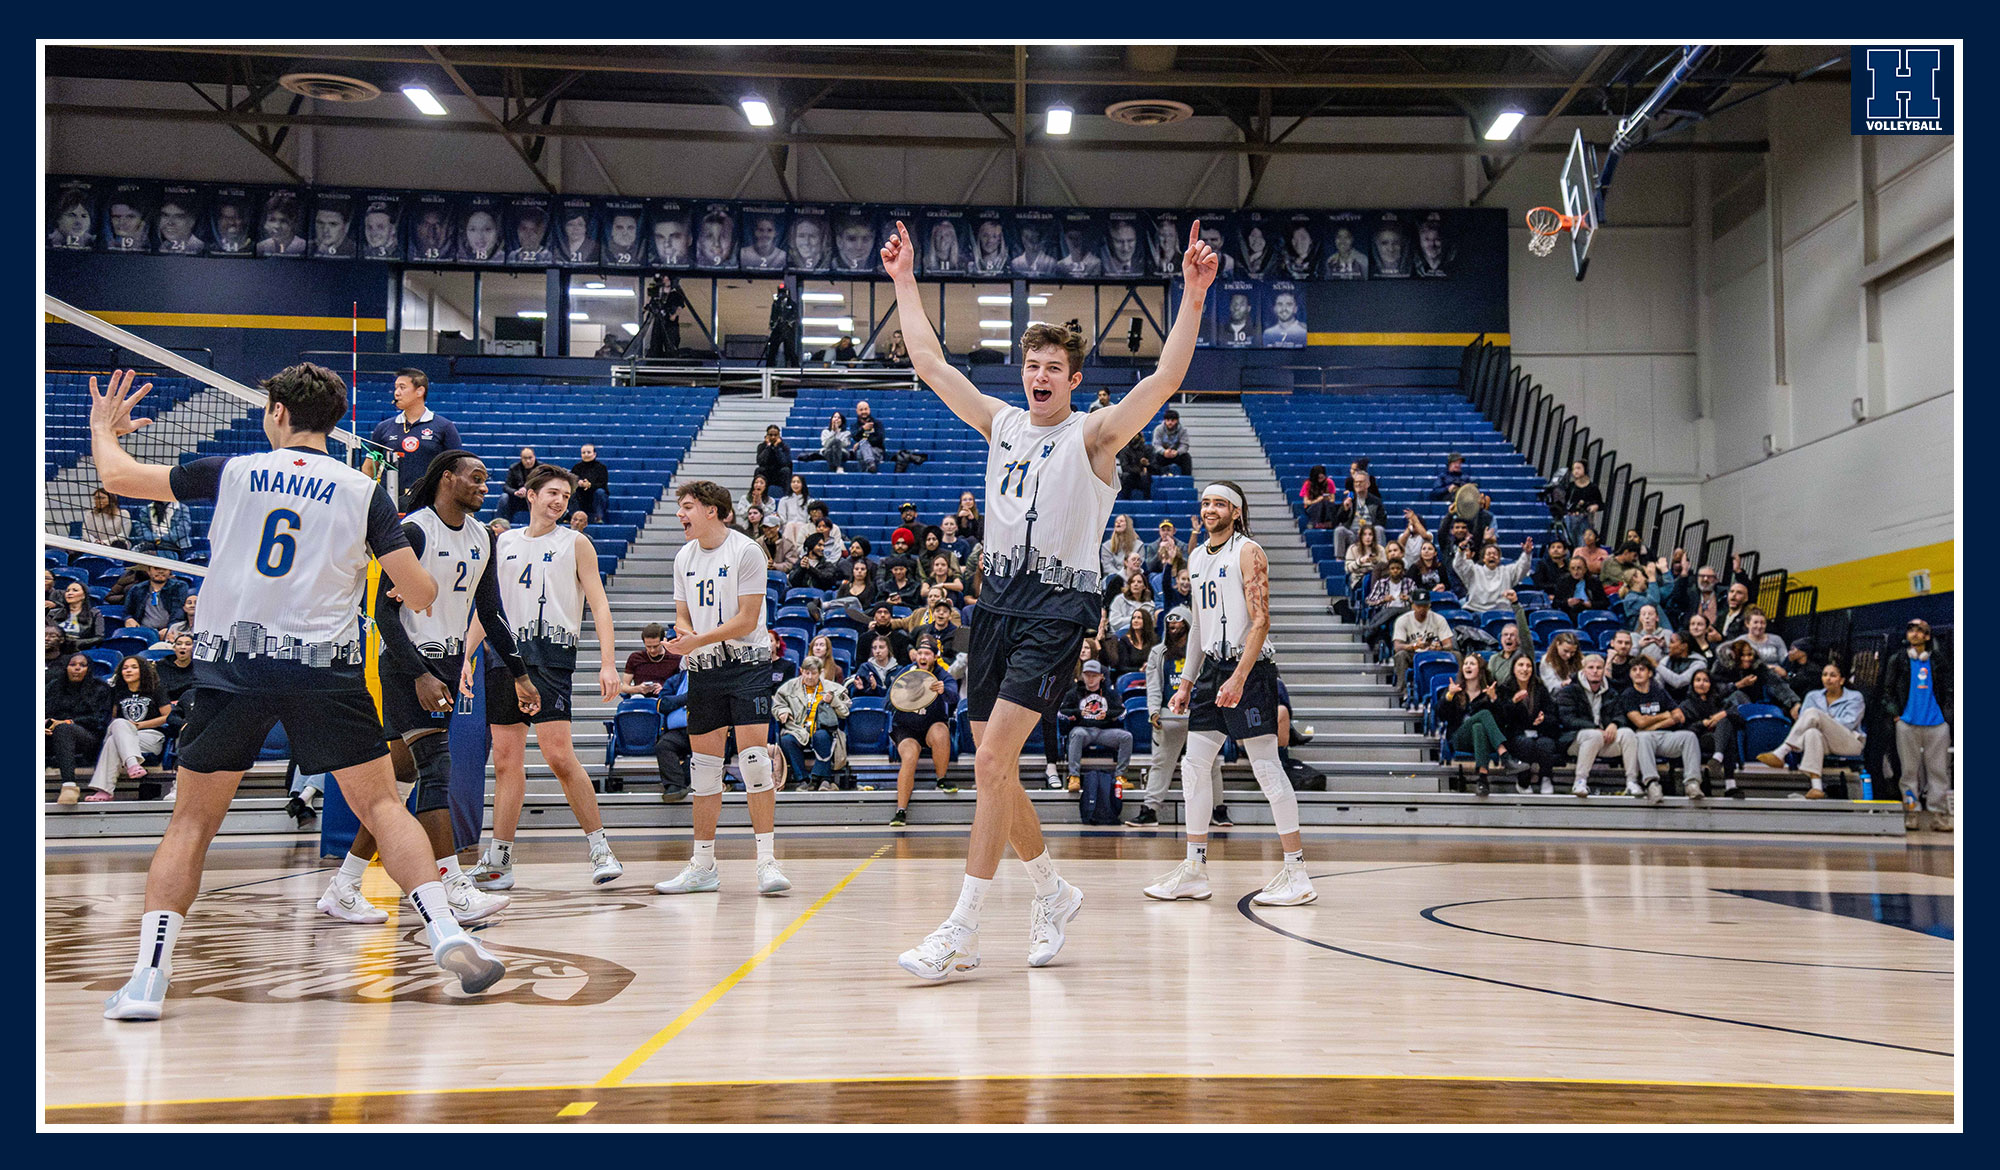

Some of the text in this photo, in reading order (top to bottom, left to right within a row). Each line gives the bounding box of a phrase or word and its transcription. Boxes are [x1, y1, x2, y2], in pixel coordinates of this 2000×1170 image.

[121, 237, 134, 247] 19
[328, 246, 337, 255] 6
[378, 247, 386, 256] 3
[475, 250, 488, 260] 18
[523, 251, 537, 261] 22
[570, 252, 583, 262] 21
[618, 253, 632, 263] 29
[713, 256, 721, 266] 9
[760, 257, 767, 267] 2
[805, 258, 813, 268] 5
[850, 258, 858, 269] 3
[940, 261, 950, 270] 11
[986, 261, 994, 270] 8
[1162, 263, 1175, 273] 10
[1234, 331, 1246, 341] 10
[1281, 332, 1288, 342] 7
[1000, 459, 1031, 498] 11
[250, 469, 337, 505] MANNA
[255, 507, 302, 579] 6
[453, 561, 467, 592] 2
[518, 562, 533, 589] 4
[718, 567, 727, 577] H
[1218, 567, 1227, 577] H
[695, 578, 715, 607] 13
[1199, 580, 1217, 610] 16
[752, 696, 769, 715] 13
[1244, 707, 1262, 728] 16
